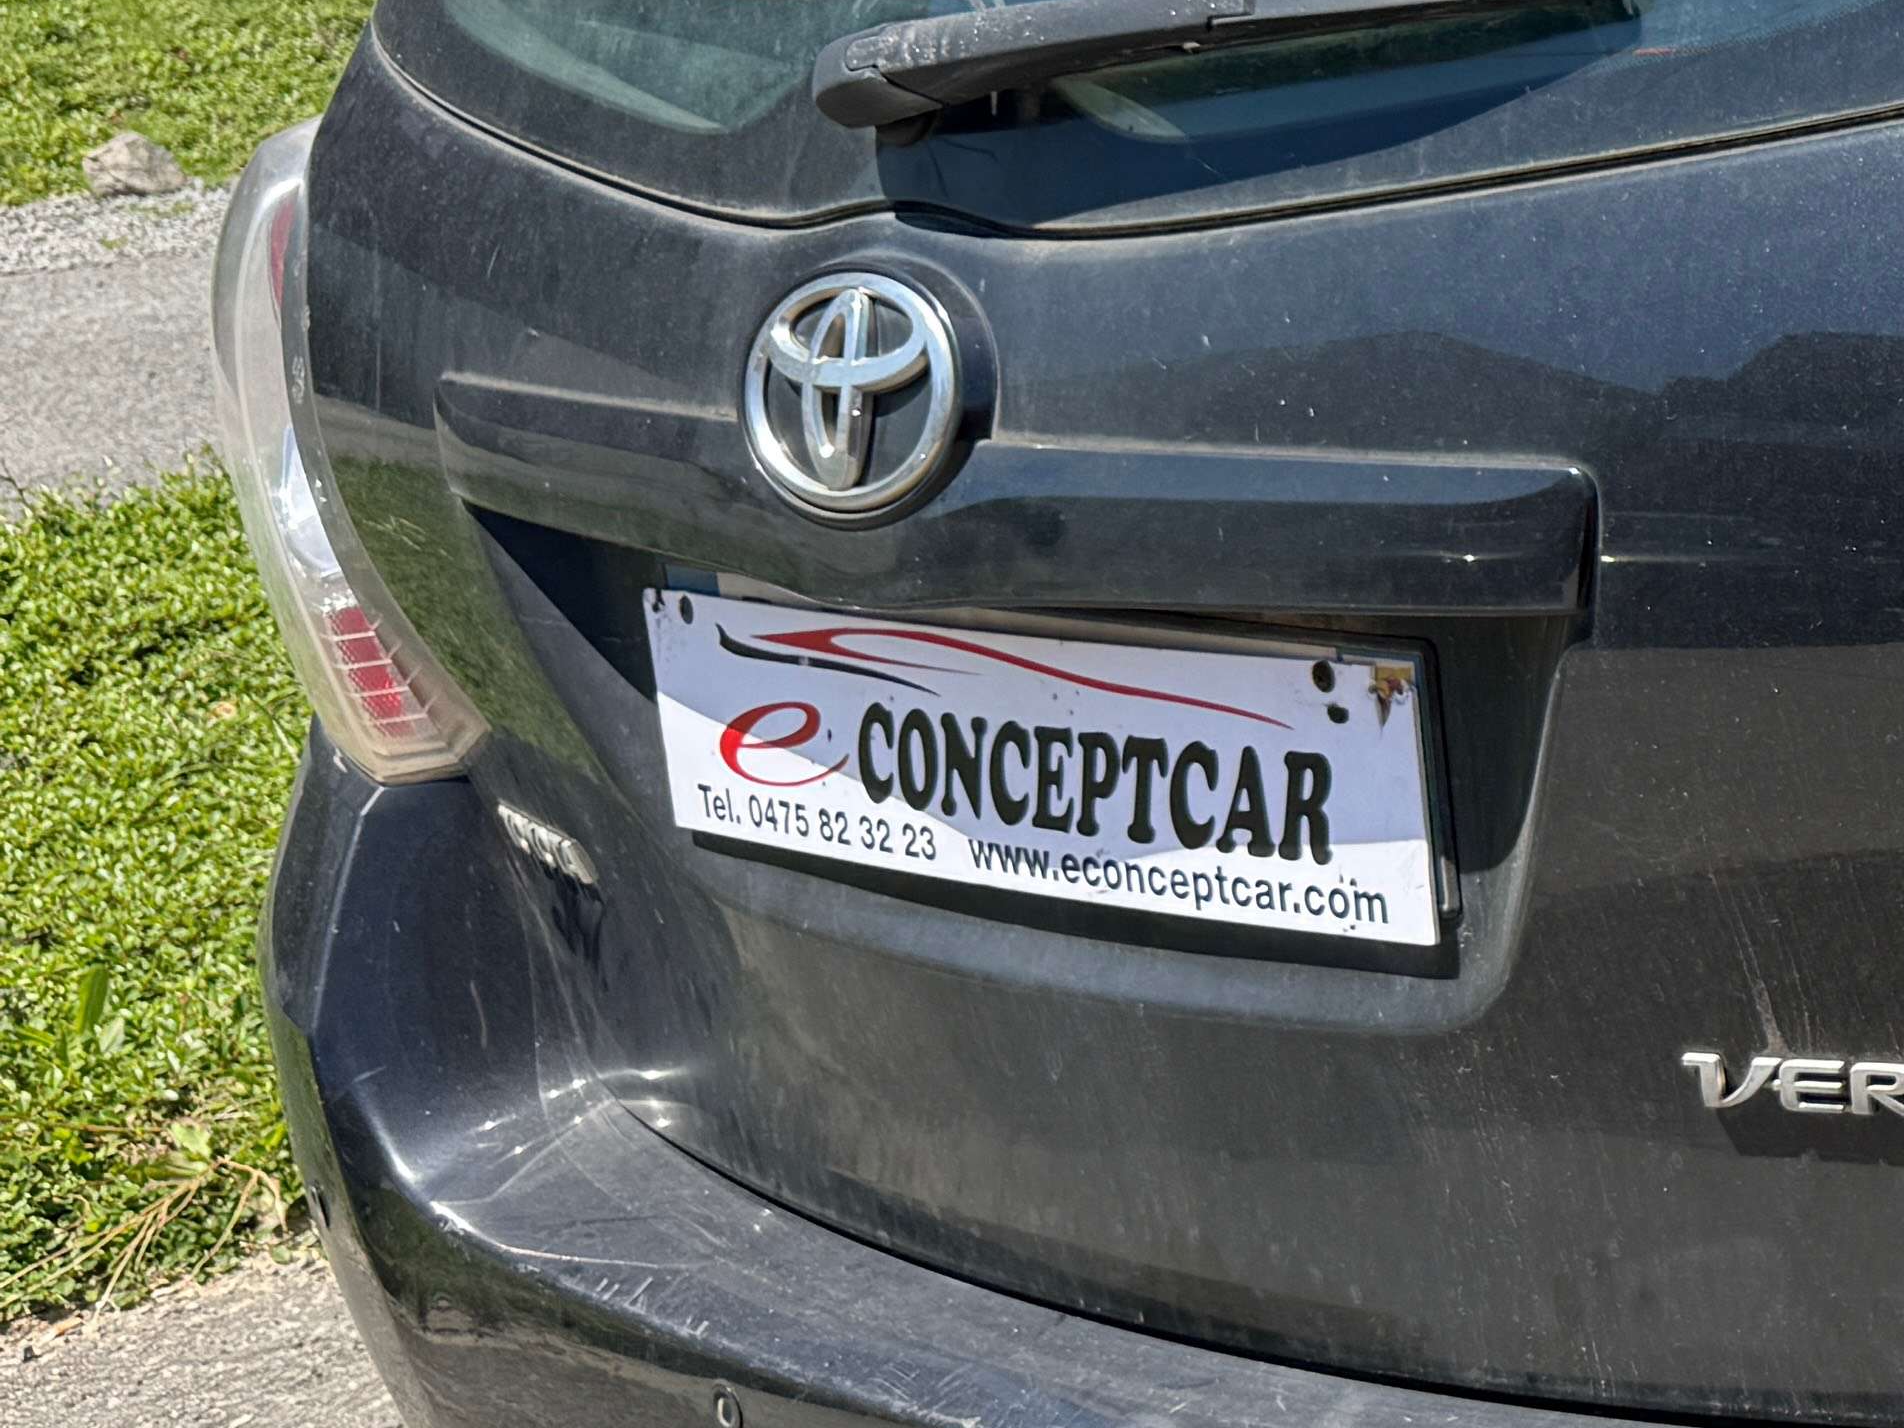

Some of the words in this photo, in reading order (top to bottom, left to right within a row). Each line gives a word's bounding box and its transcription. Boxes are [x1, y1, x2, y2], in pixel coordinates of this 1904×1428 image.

[697, 783, 742, 824] Tel.
[748, 794, 810, 838] 0475
[818, 807, 851, 846] 82
[859, 815, 894, 854] 32
[902, 822, 937, 861] 23
[967, 838, 1390, 924] www.econceptcar.com
[857, 701, 1334, 867] CONCEPTCAR
